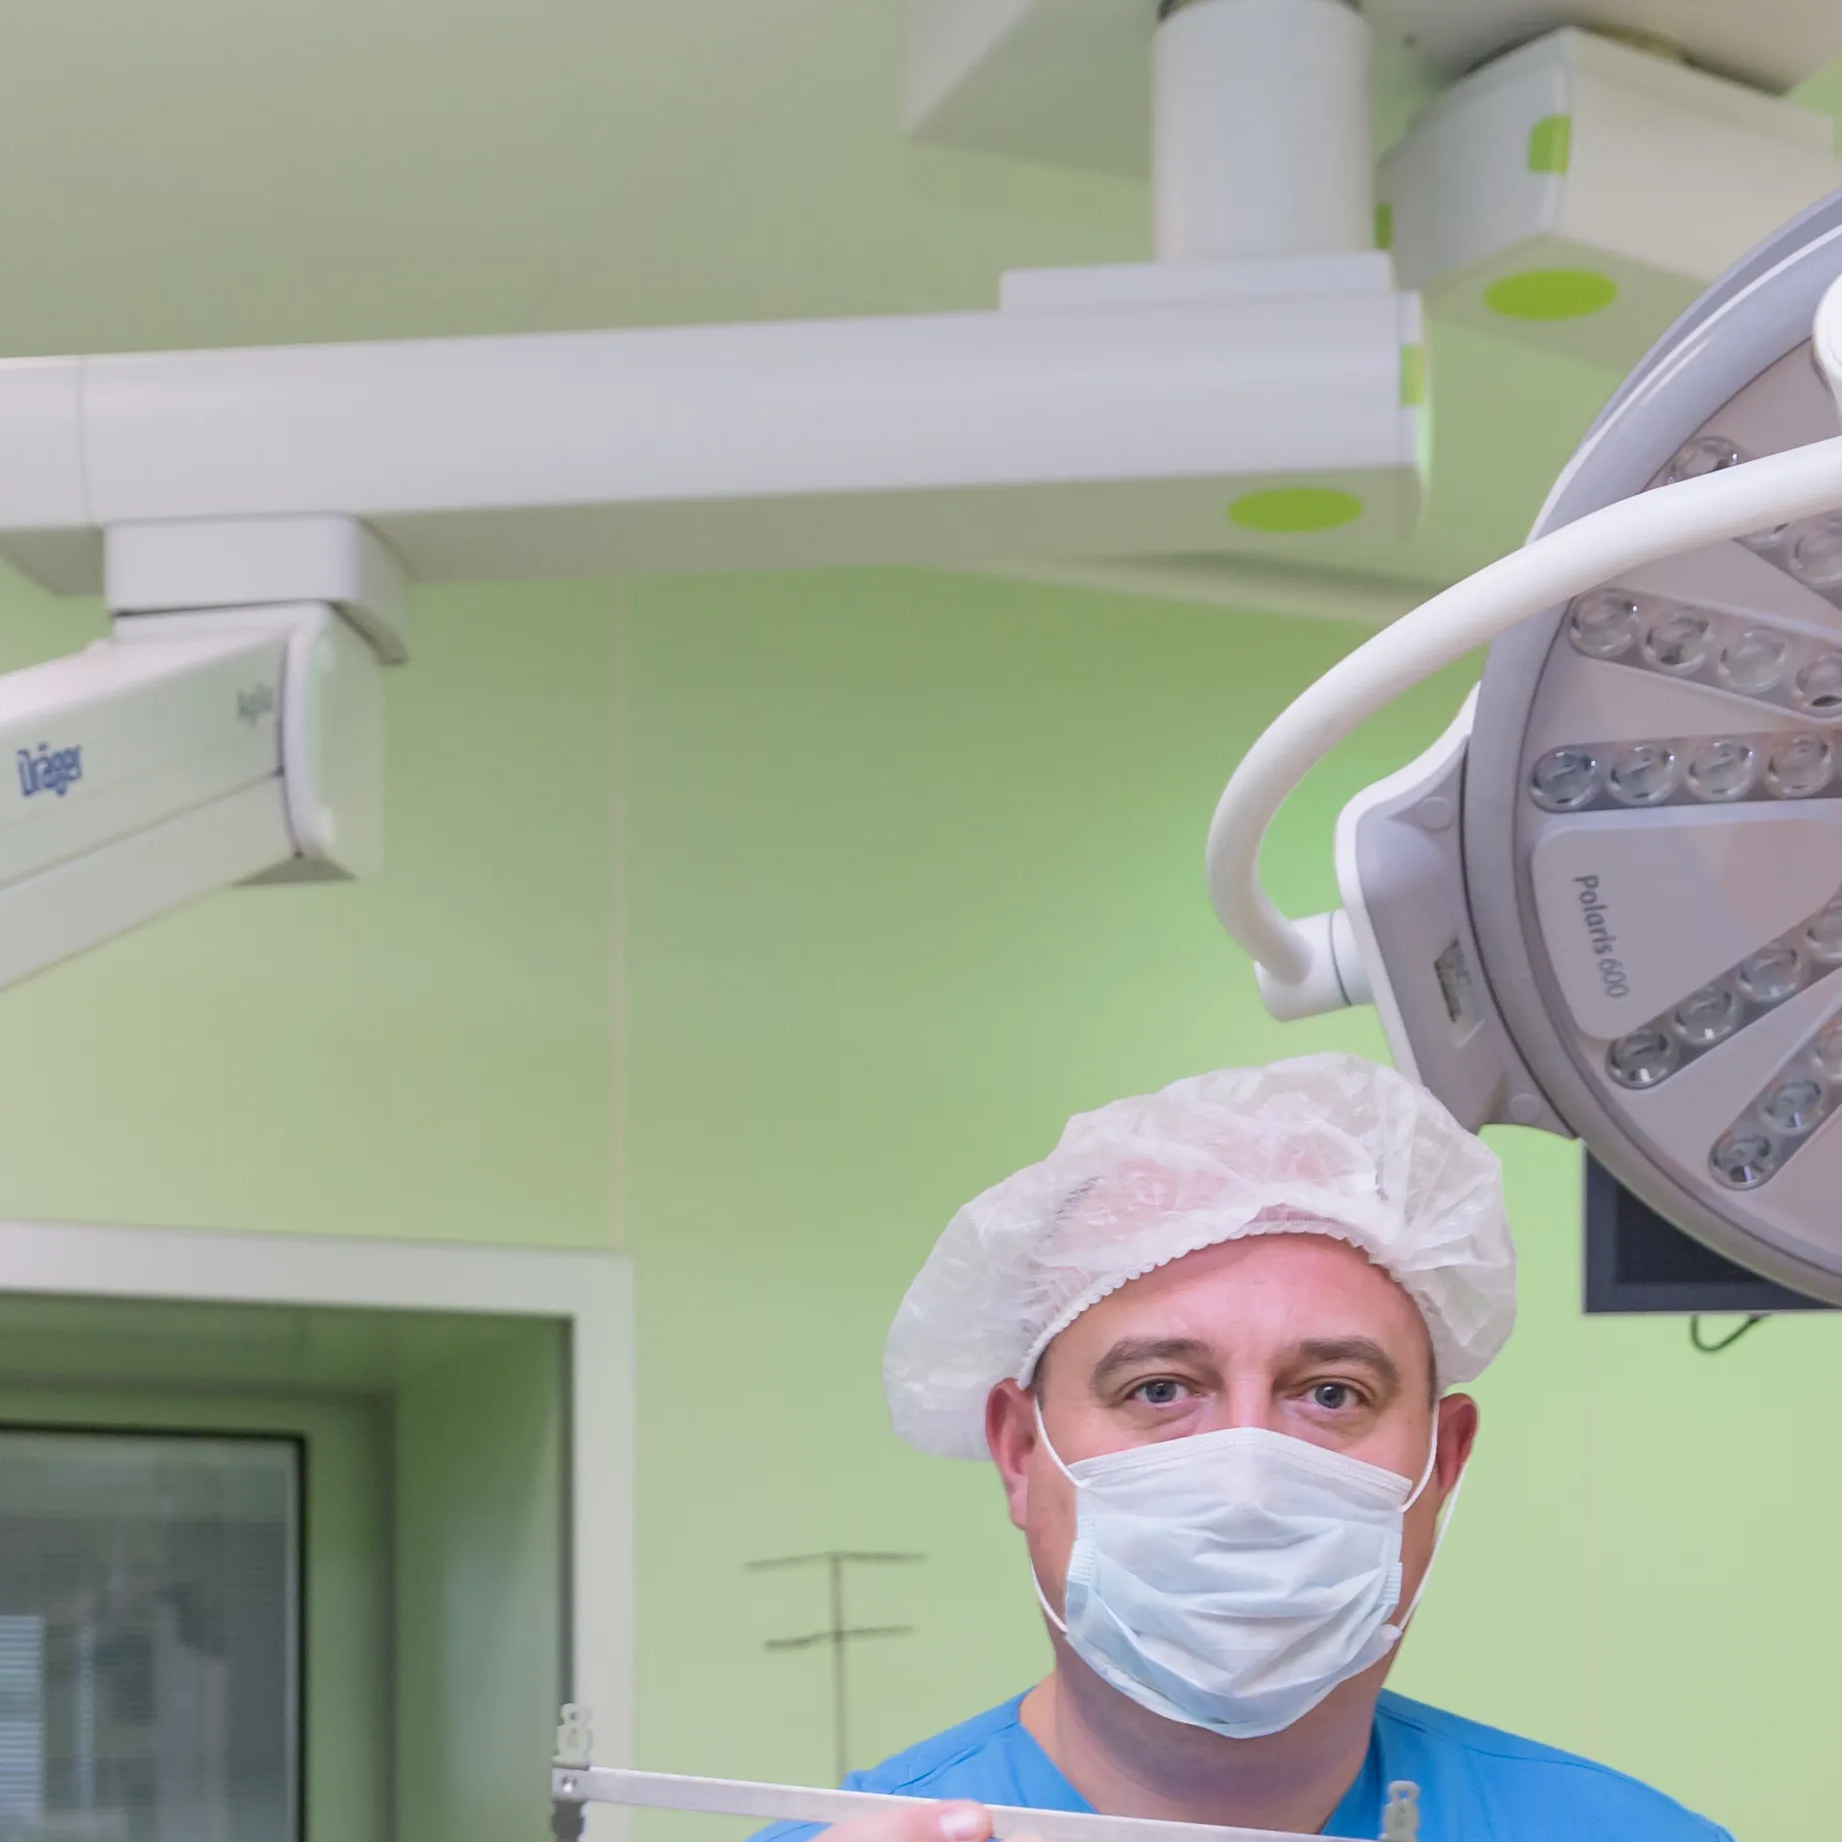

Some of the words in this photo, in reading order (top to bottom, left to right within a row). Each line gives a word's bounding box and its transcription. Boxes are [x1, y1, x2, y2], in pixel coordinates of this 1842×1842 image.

[16, 741, 83, 799] Dräger
[1573, 874, 1617, 955] Polaris
[1598, 958, 1630, 998] 600
